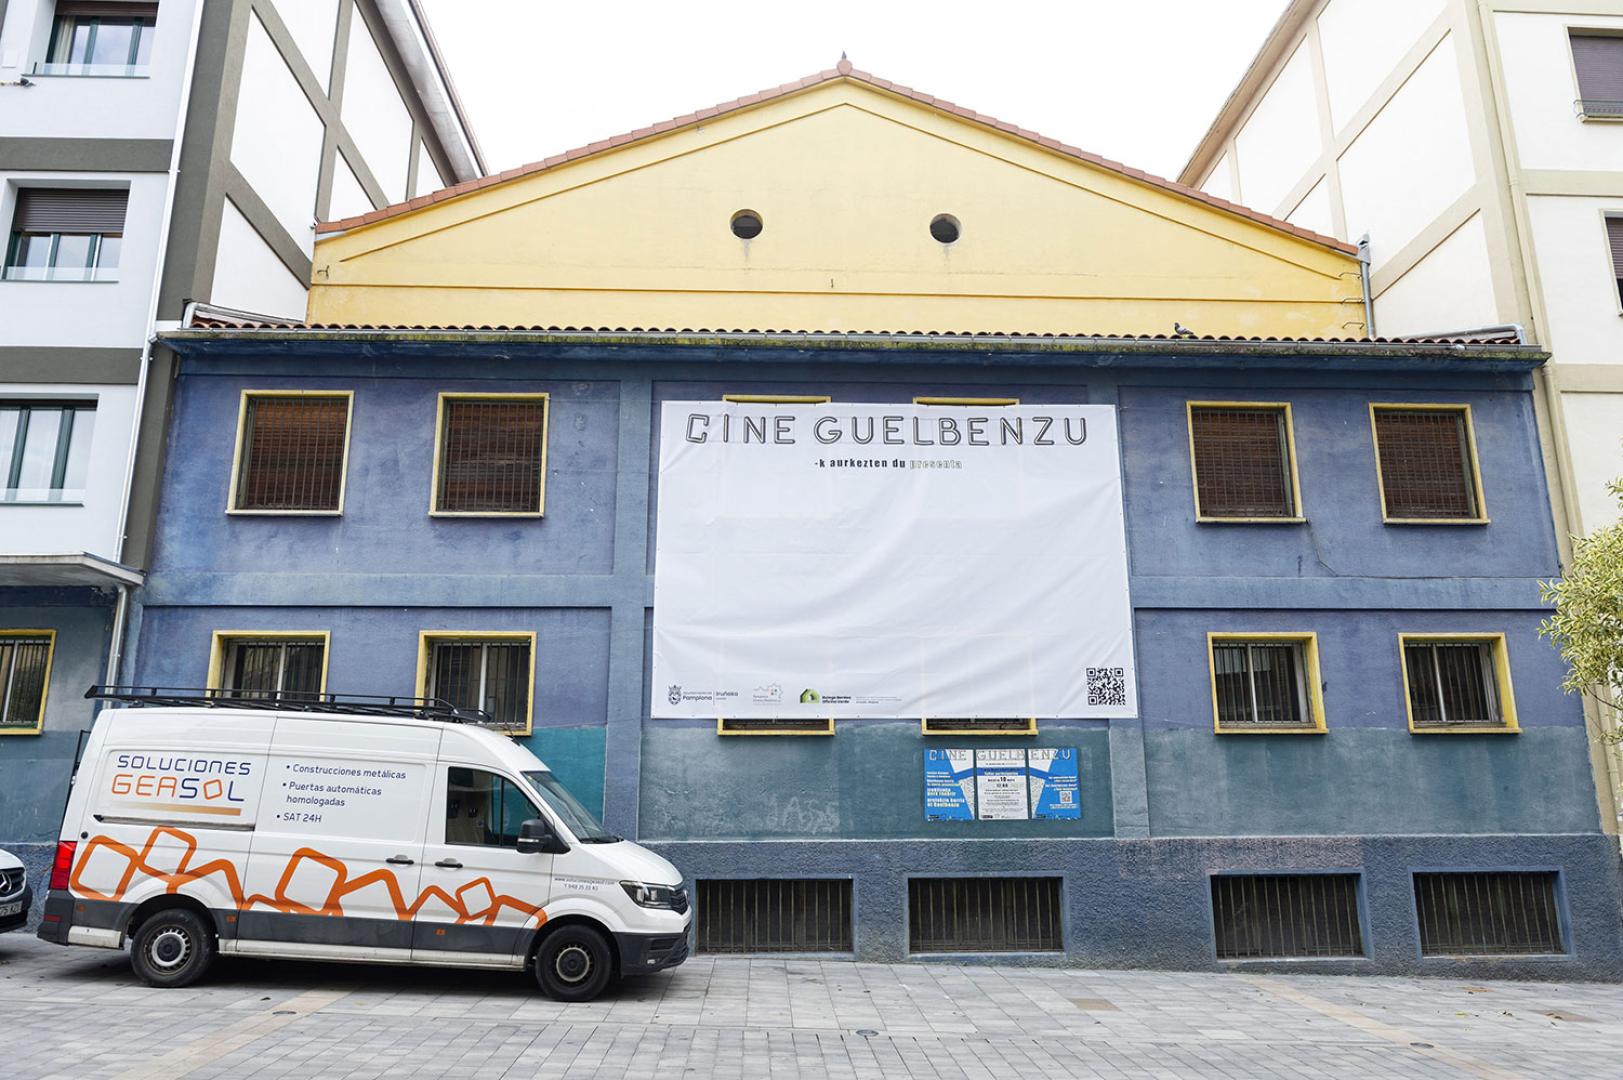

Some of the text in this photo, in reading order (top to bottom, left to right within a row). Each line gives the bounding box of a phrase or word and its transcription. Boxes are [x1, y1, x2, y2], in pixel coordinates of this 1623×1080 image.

[685, 413, 1088, 446] CINE GUELBENZU
[829, 457, 889, 468] aurkezten
[891, 458, 907, 468] du
[908, 459, 963, 470] presenta
[117, 754, 252, 776] SOLUCIONES
[292, 763, 407, 780] Construcciones metálicas
[111, 773, 245, 803] GEASOL
[288, 781, 382, 796] Puertas automáticas
[286, 794, 346, 808] homologadas
[283, 812, 322, 824] SAT 24H
